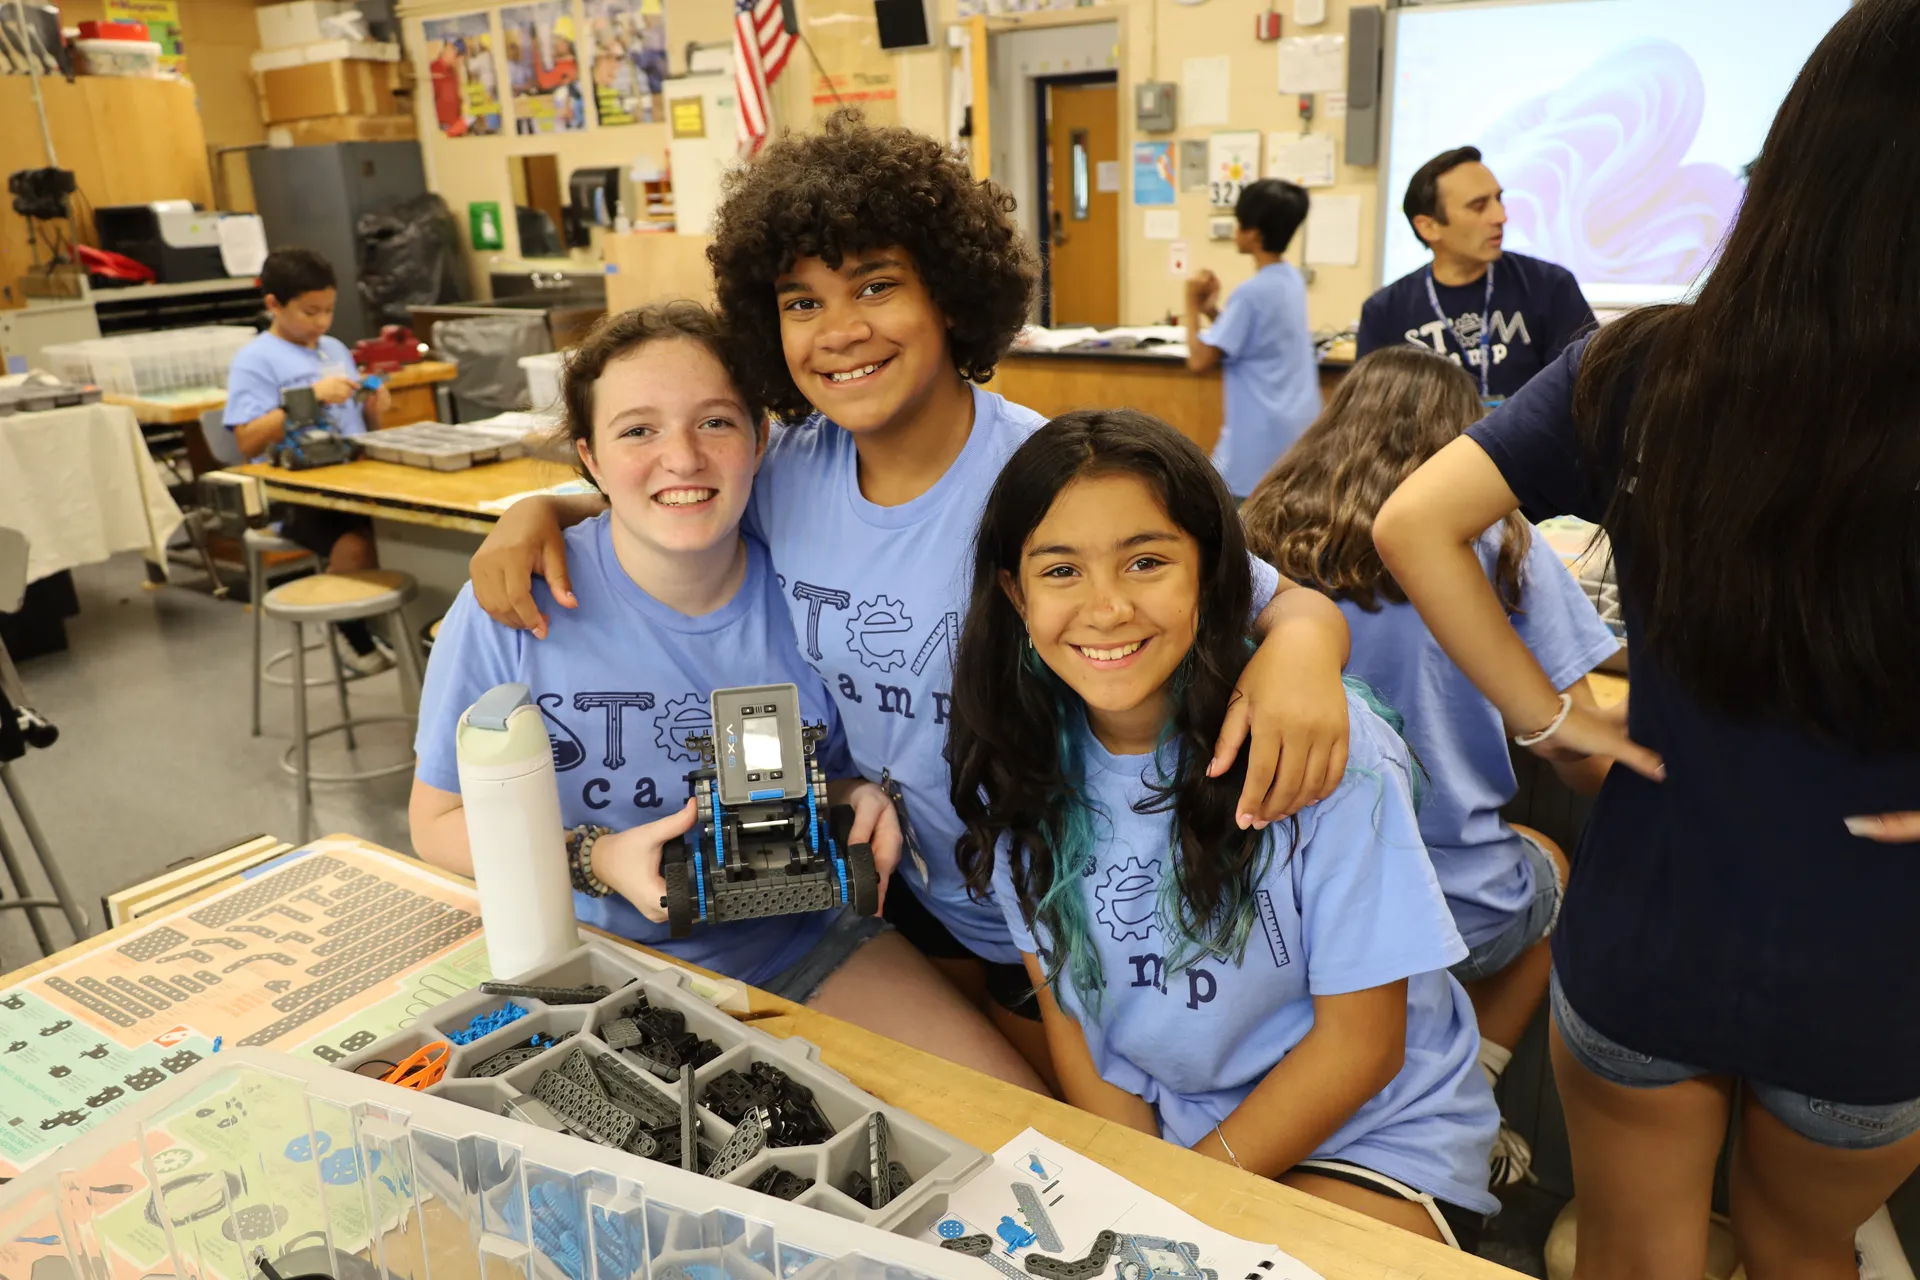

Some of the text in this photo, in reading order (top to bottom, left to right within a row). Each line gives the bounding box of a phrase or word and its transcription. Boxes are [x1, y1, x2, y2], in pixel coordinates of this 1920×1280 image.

[1210, 182, 1244, 204] 32
[805, 661, 951, 725] amp
[726, 723, 738, 755] VEX
[582, 777, 699, 810] ca
